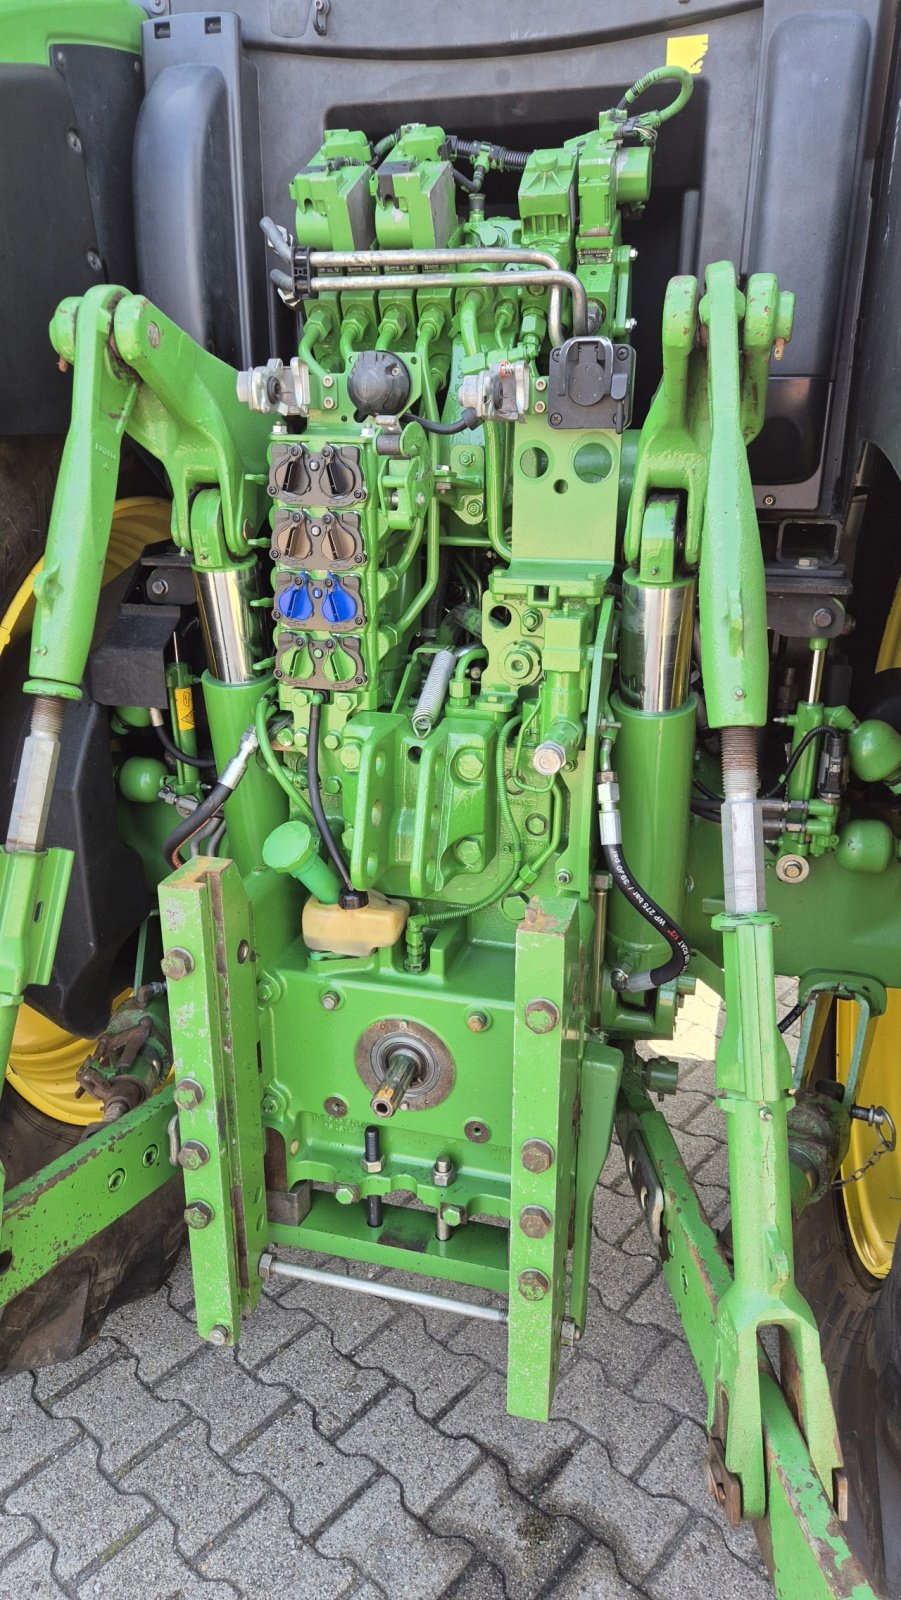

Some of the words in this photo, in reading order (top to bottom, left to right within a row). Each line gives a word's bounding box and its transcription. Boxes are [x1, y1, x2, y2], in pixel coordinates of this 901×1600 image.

[633, 892, 644, 904] bar
[642, 902, 656, 916] 275
[654, 915, 666, 926] WP
[677, 941, 689, 955] R2AT
